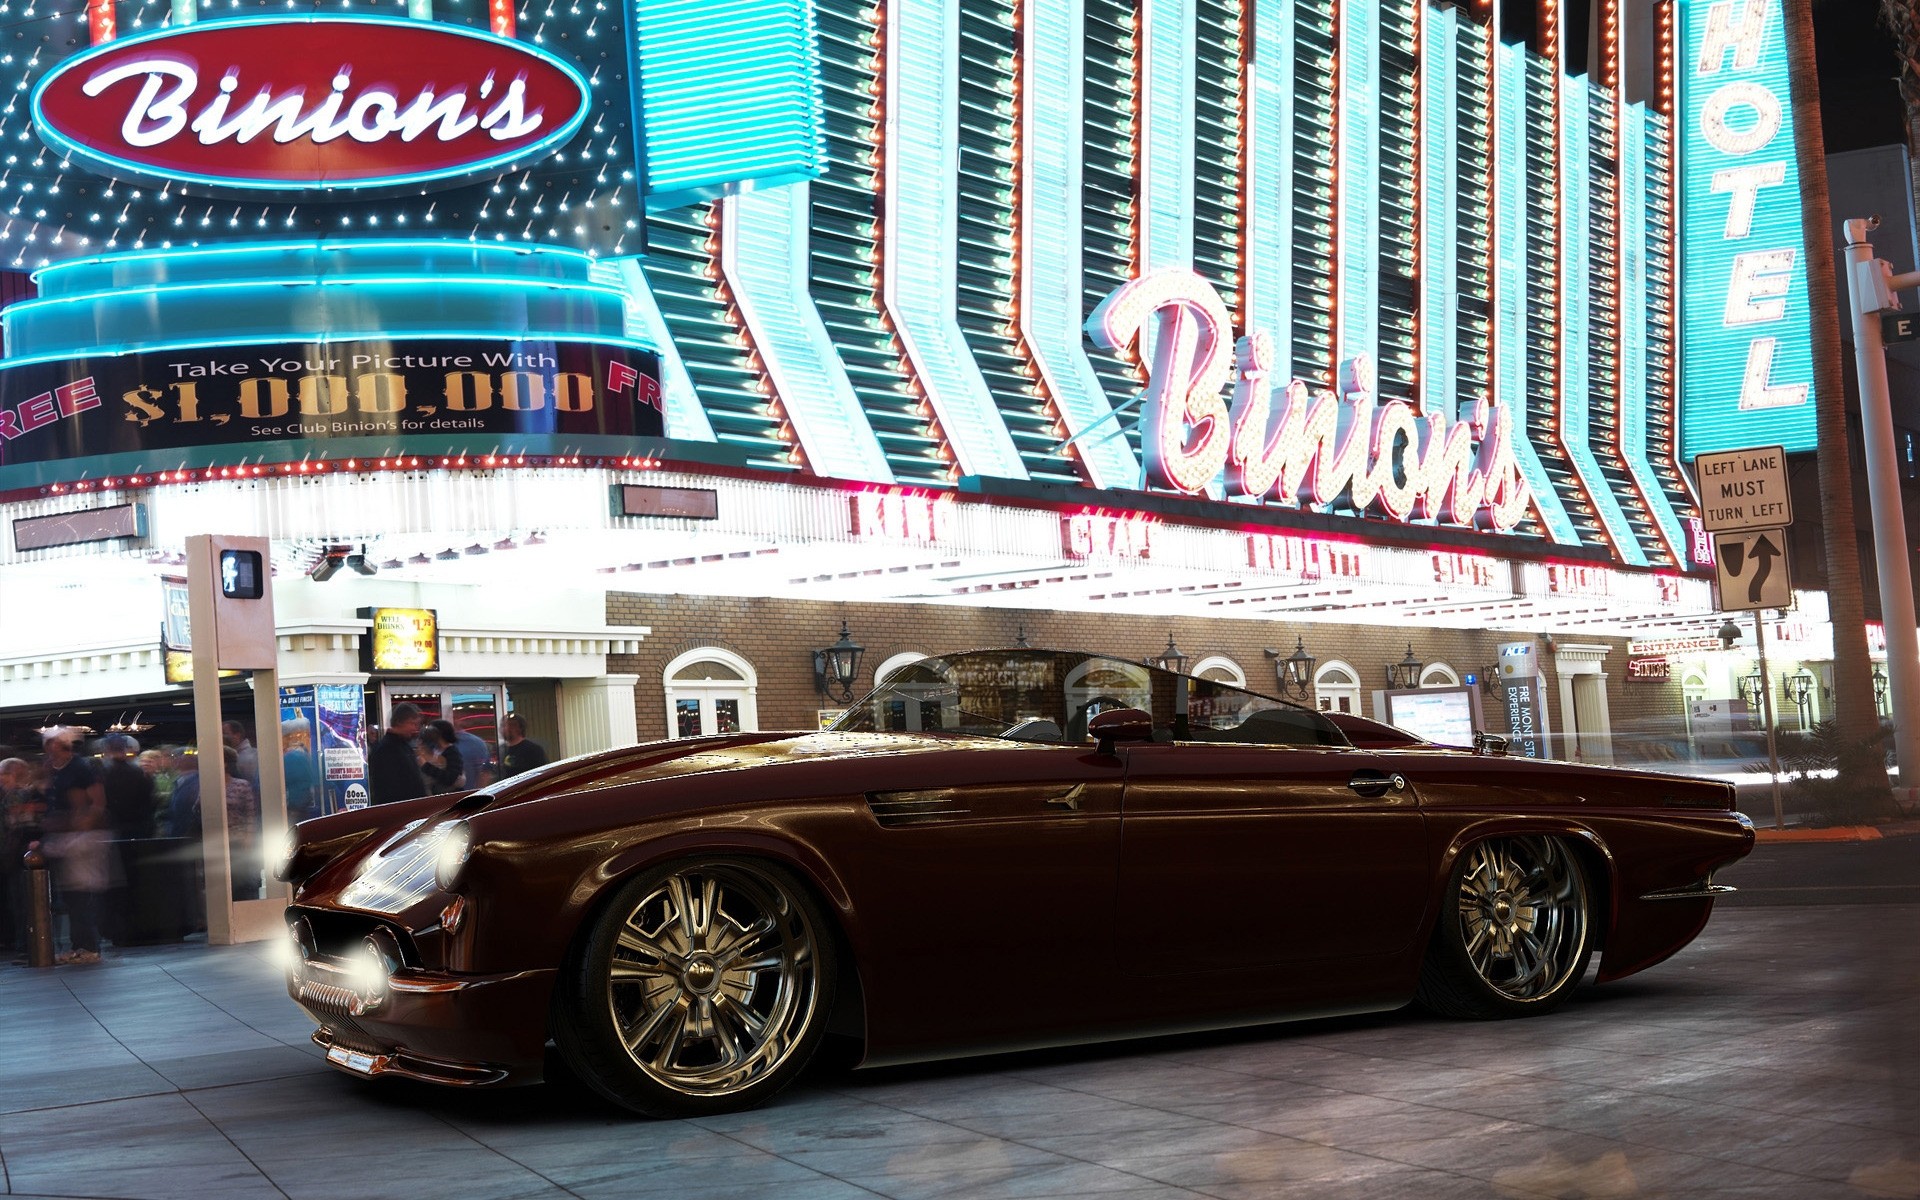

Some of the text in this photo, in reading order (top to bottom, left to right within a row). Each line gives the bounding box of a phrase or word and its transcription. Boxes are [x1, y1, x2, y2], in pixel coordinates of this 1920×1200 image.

[83, 58, 543, 147] Binion's
[1697, 0, 1809, 411] HOTEL
[1897, 319, 1912, 336] E
[169, 352, 556, 378] Take Your Picture With
[122, 371, 594, 427] $1,000,000
[1086, 268, 1530, 532] Binion's
[251, 418, 484, 436] See Club Binion's for details
[1704, 457, 1777, 476] LEFT LANE
[1721, 480, 1765, 499] MUST
[1708, 502, 1784, 522] TURN LEFT
[1632, 638, 1720, 655] ENTRANCE
[1630, 659, 1671, 677] BINION'S
[1508, 686, 1522, 743] EXPERIENCE
